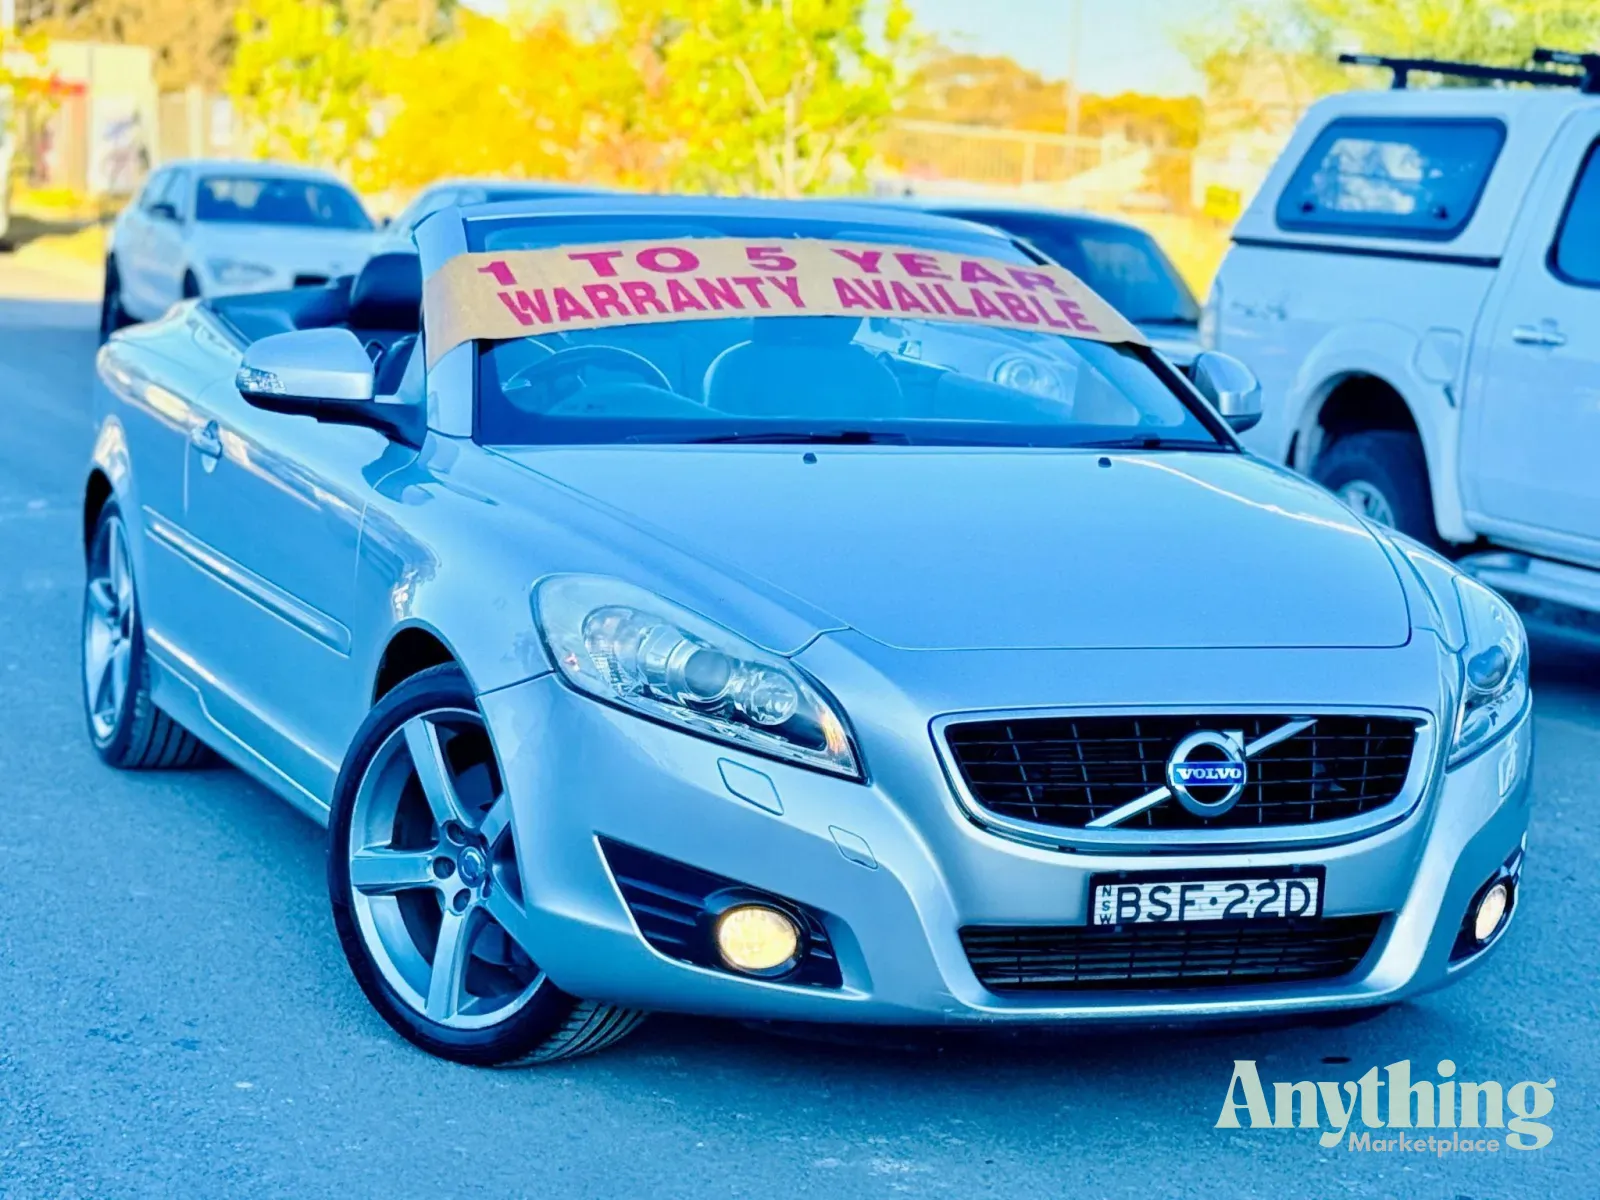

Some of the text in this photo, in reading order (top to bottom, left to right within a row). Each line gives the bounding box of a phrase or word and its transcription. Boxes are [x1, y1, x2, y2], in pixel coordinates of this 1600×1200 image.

[478, 246, 1067, 297] 1 TO 5 YEAR
[499, 275, 1101, 333] WARRANTY AVAILABLE
[1175, 767, 1242, 780] VOLVO
